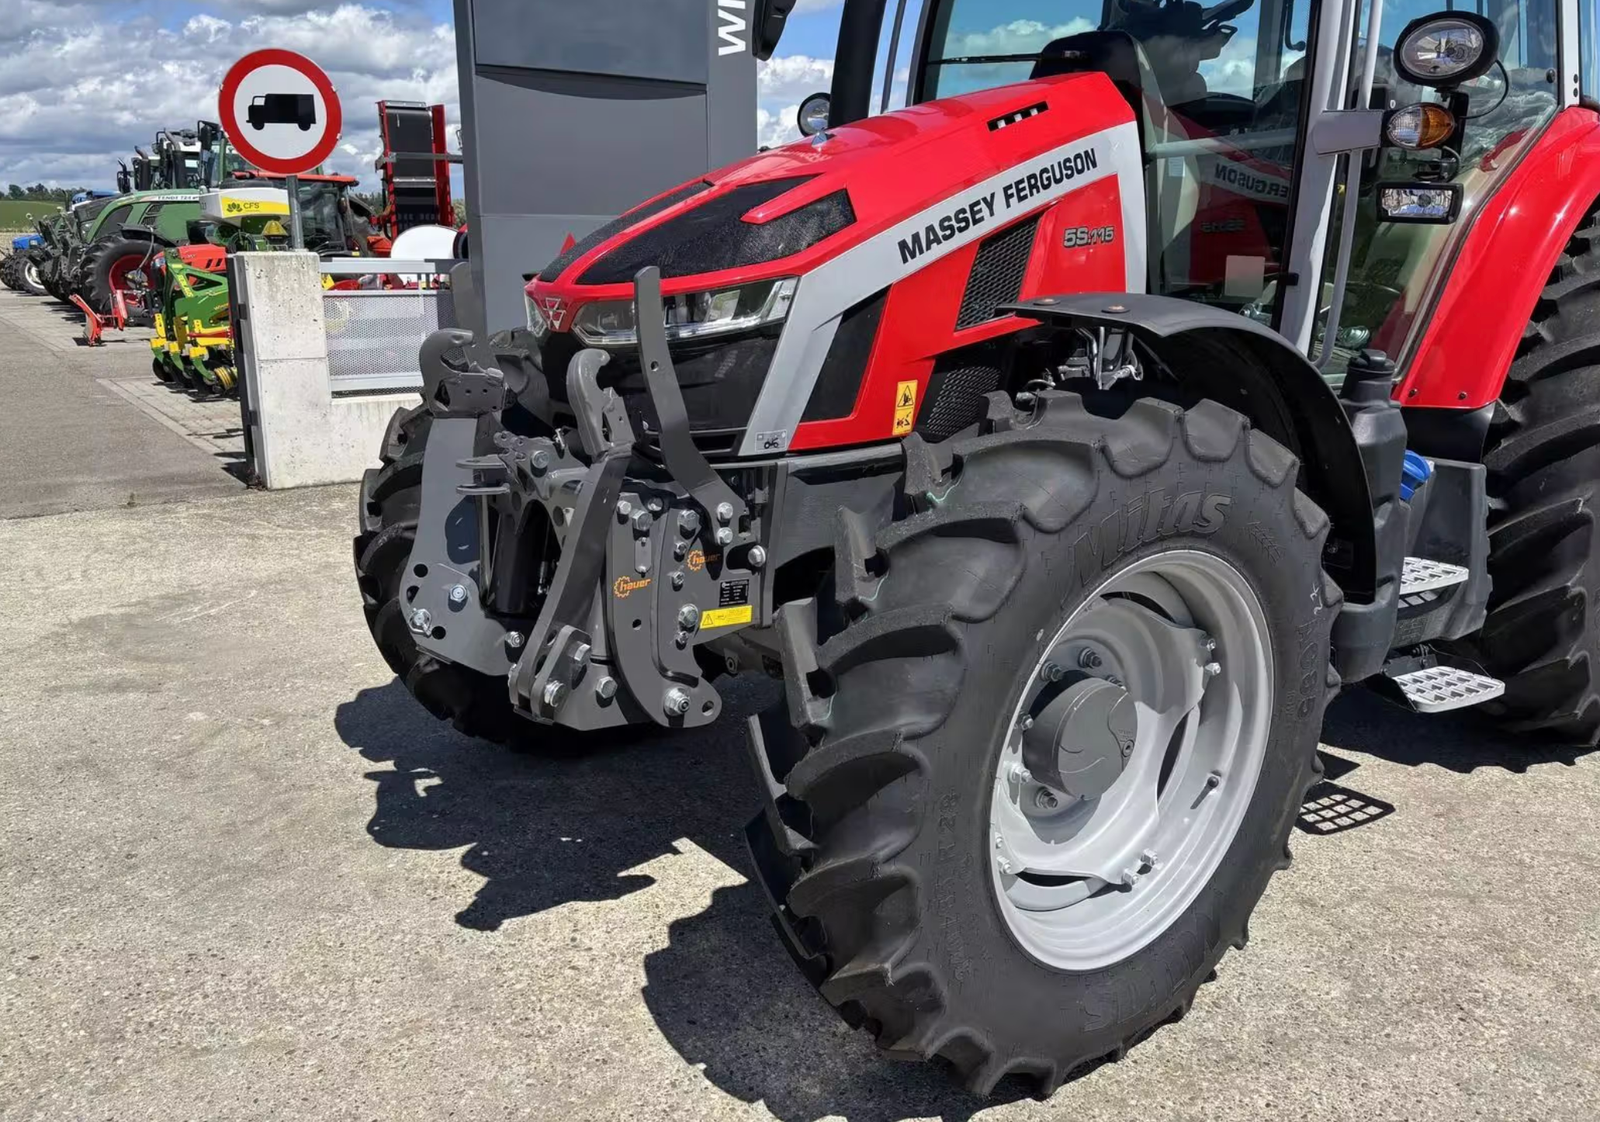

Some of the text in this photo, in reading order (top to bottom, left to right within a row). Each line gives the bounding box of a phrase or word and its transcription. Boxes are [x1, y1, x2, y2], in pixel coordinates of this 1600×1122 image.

[897, 148, 1098, 265] MASSEY FERGUSON
[619, 578, 651, 592] hauer
